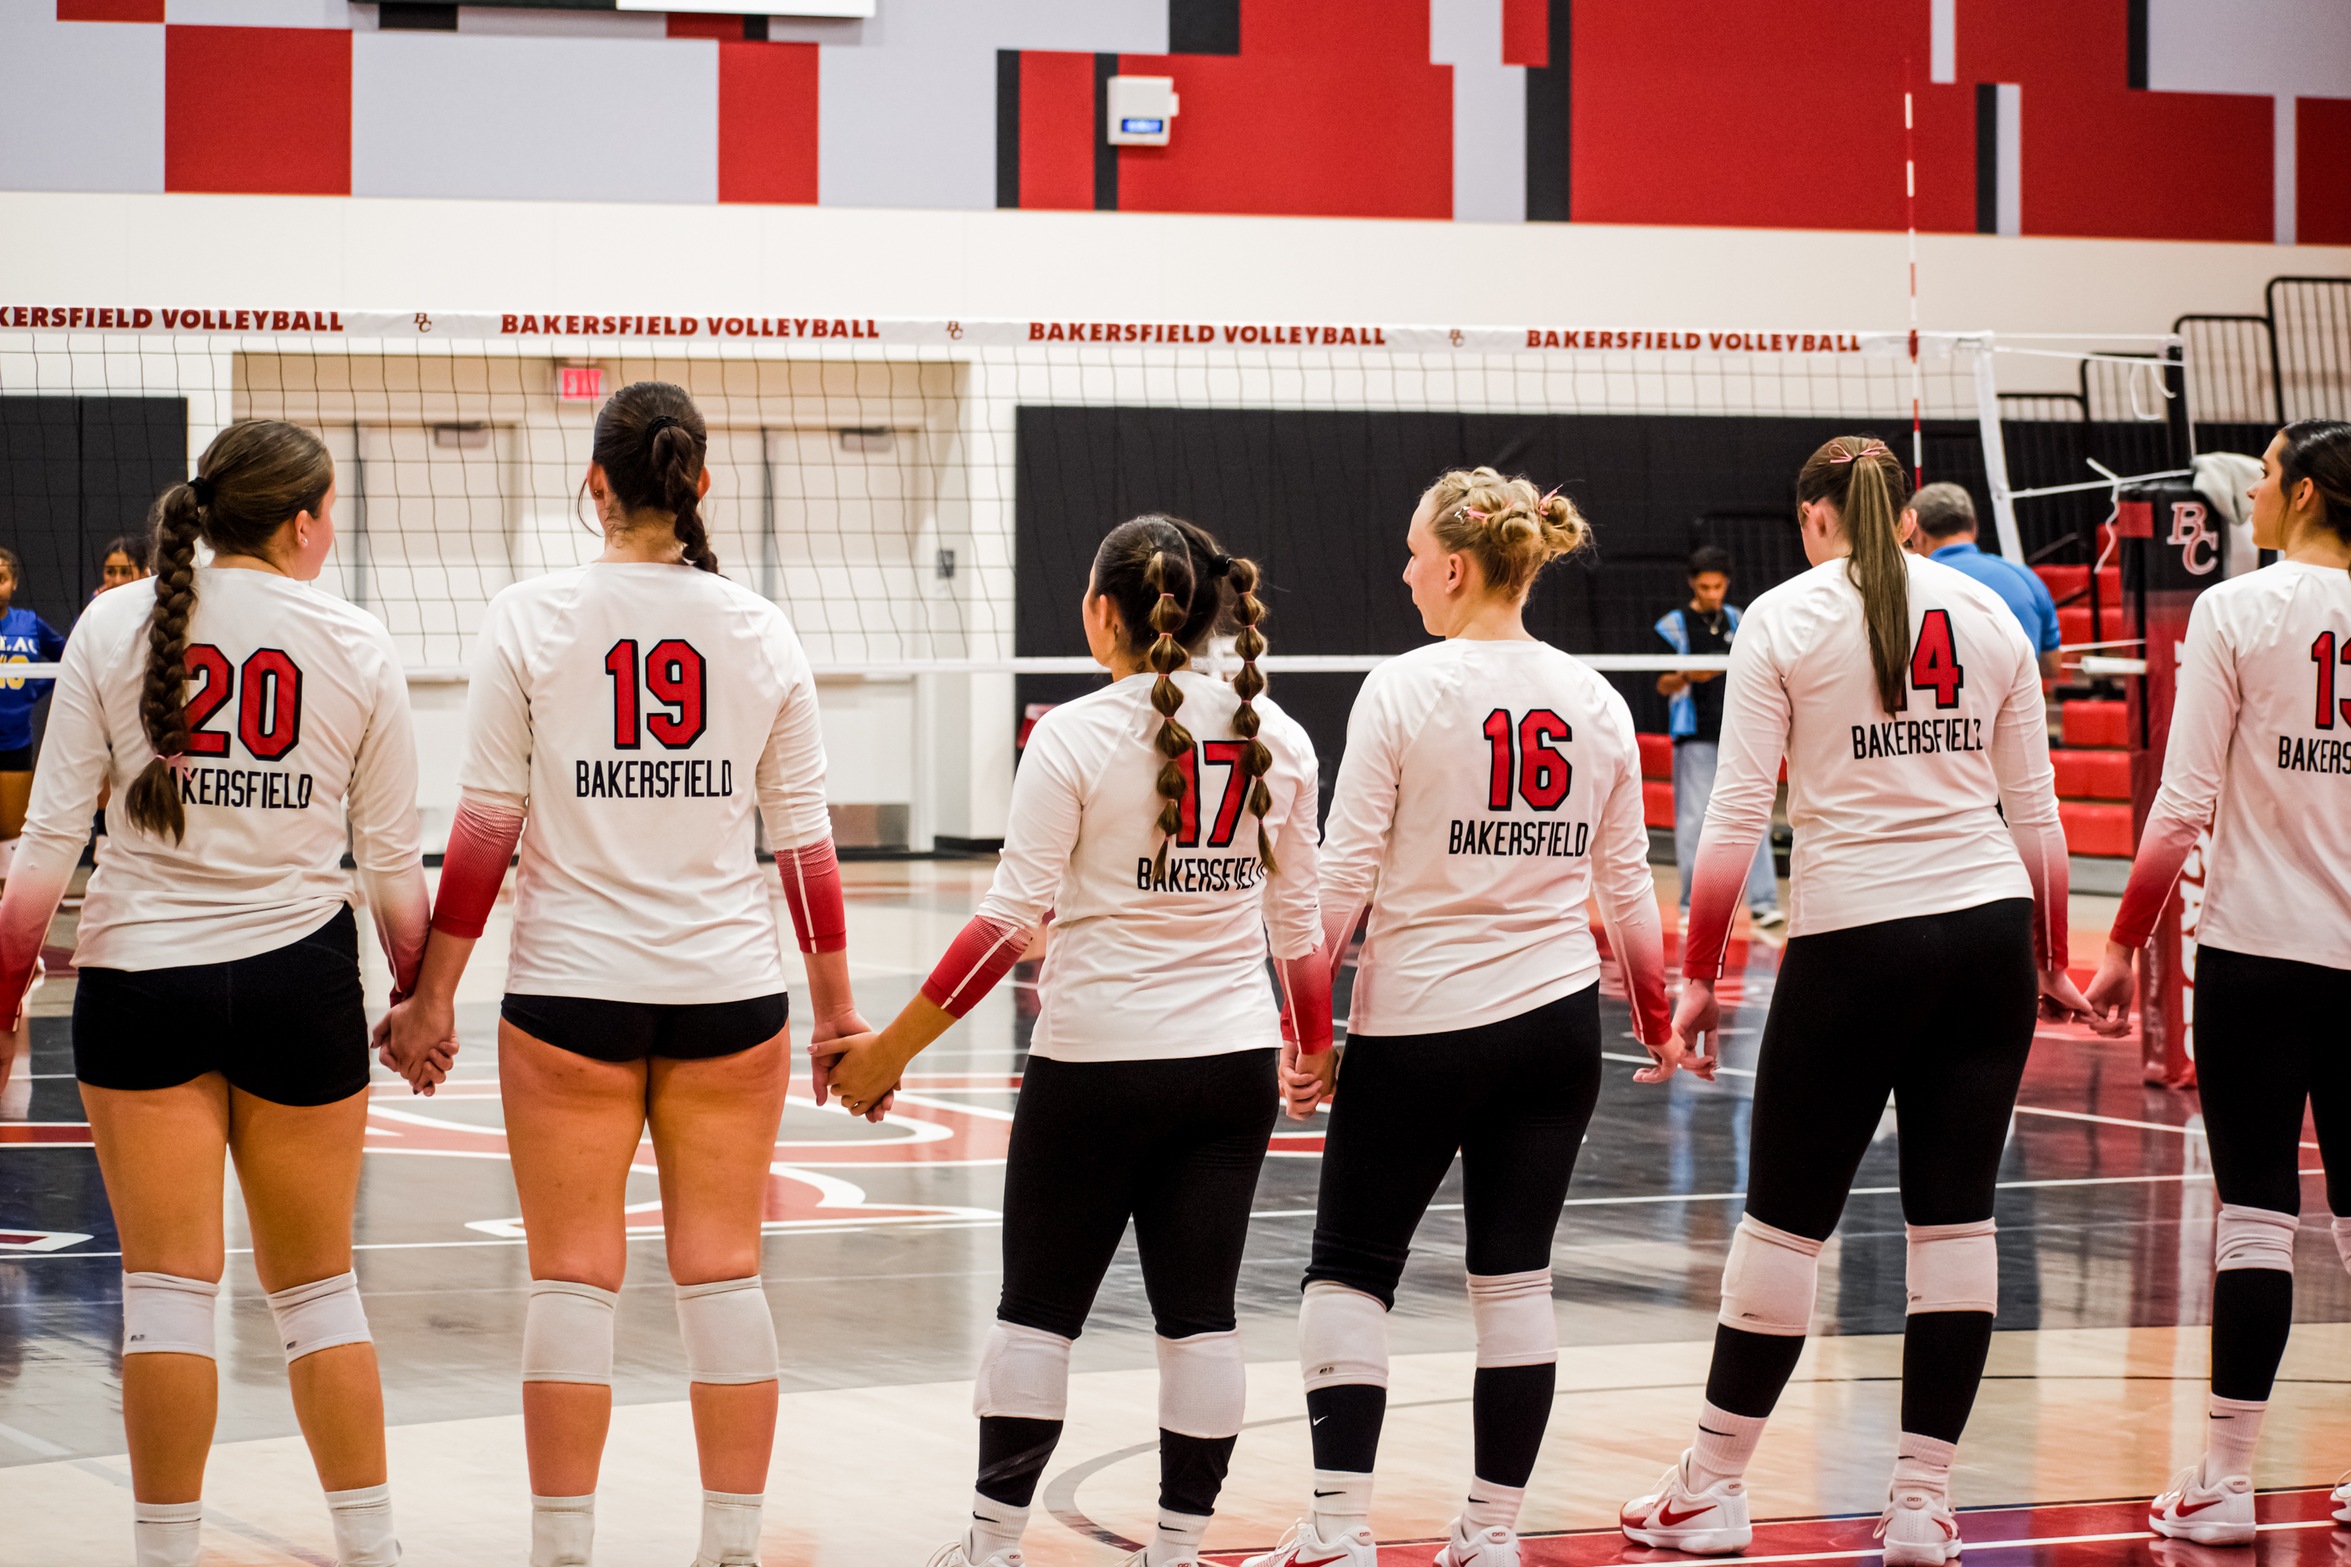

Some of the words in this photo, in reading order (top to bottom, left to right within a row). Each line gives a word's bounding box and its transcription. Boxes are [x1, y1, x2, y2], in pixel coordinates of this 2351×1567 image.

[162, 308, 344, 332] VOLLEYBALL
[500, 314, 699, 336] BAKERSFIELD
[707, 316, 880, 339] VOLLEYBALL
[1028, 322, 1215, 344] BAKERSFIELD
[1223, 325, 1386, 346] VOLLEYBALL
[1526, 330, 1701, 350] BAKERSFIELD
[1708, 333, 1862, 353] VOLLEYBALL
[2166, 501, 2219, 576] BC
[183, 643, 303, 762] 20
[605, 639, 707, 750] 19
[576, 760, 733, 798] BAKERSFIELD
[1483, 708, 1572, 811] 16
[169, 766, 313, 809] KERSFIELD
[1176, 740, 1252, 848] 17
[1449, 820, 1588, 857] BAKERSFIELD
